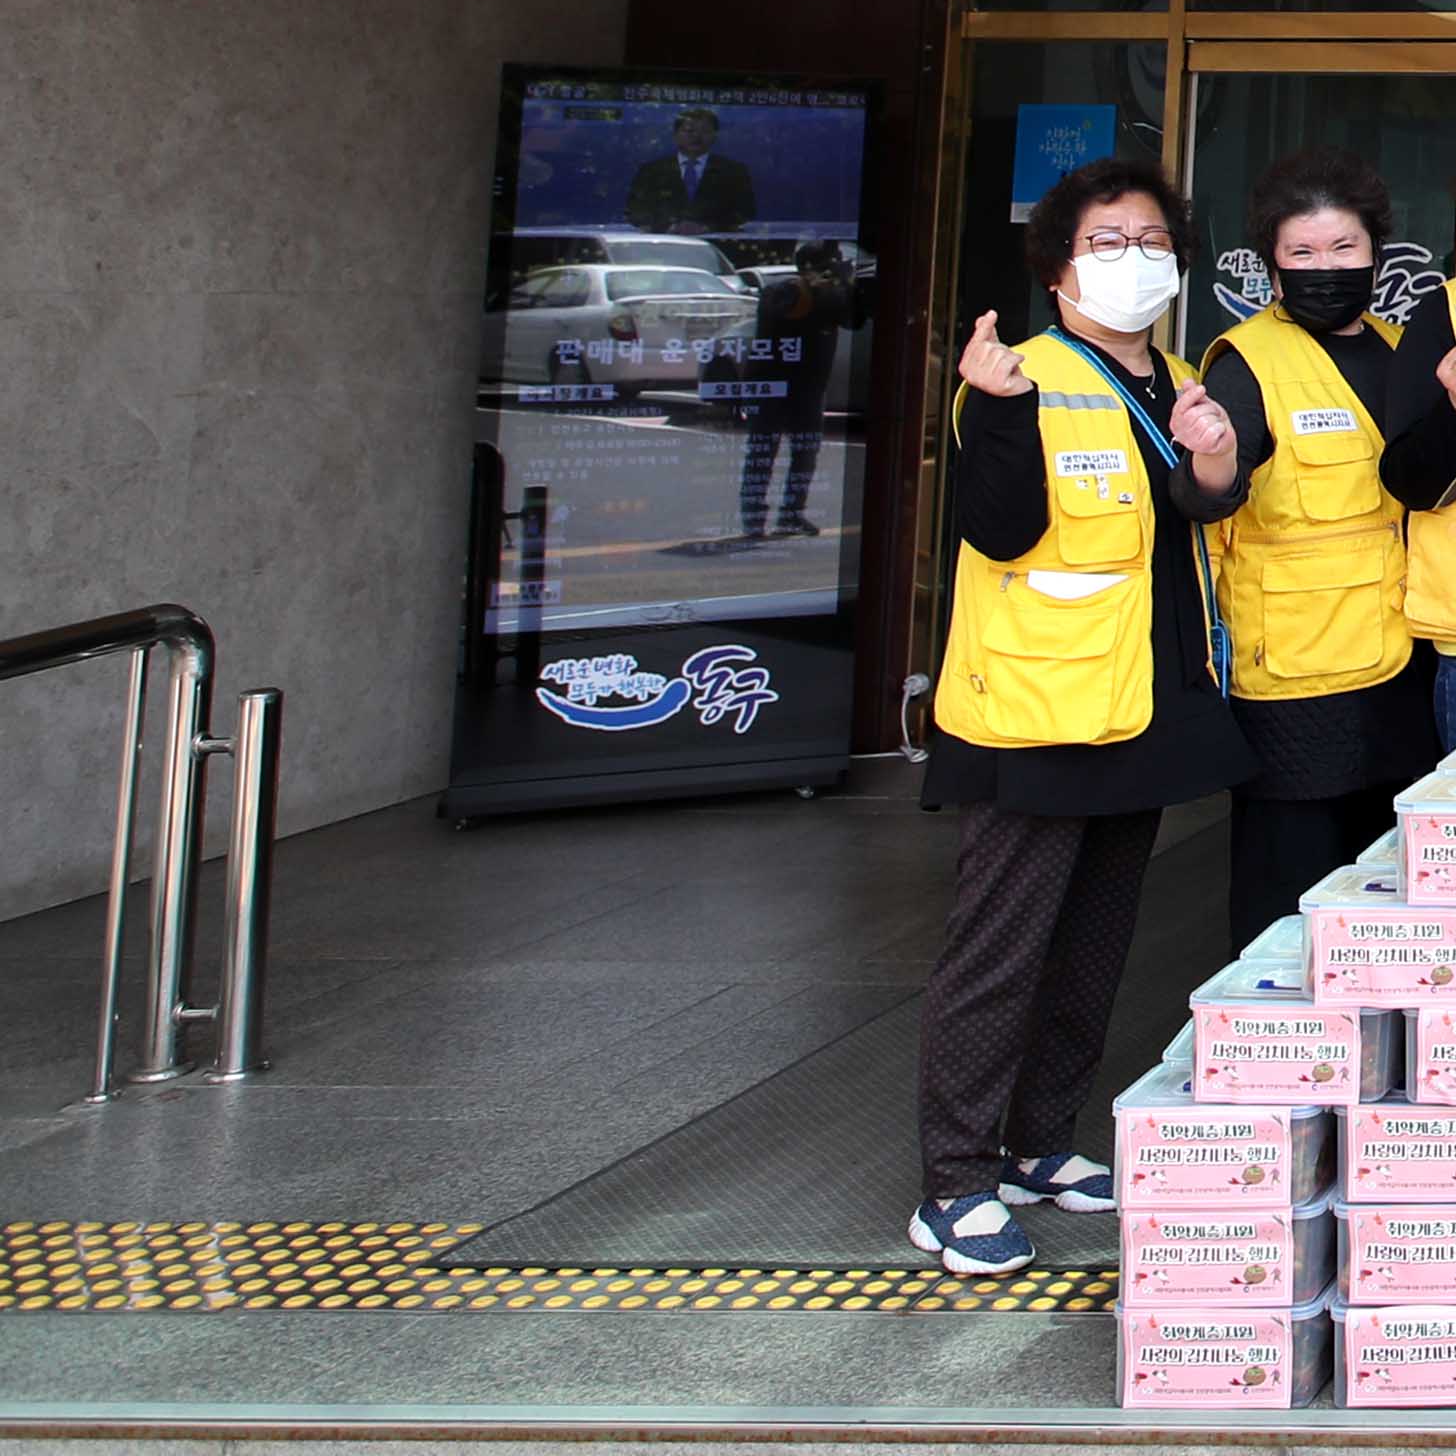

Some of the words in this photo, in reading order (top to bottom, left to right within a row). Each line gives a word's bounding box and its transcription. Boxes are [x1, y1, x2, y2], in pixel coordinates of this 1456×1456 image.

[1246, 278, 1272, 301] 모두
[556, 338, 645, 366] 판매대
[683, 645, 779, 734] 동구
[1223, 1123, 1252, 1138] 지원
[1139, 1146, 1182, 1163] 사랑의
[1185, 1146, 1243, 1163] 김치나눔
[1246, 1145, 1278, 1161] 행사
[1365, 1243, 1408, 1260] 사랑의
[1224, 1324, 1253, 1339] 지원
[1140, 1345, 1183, 1363] 사랑의
[1186, 1346, 1245, 1364] 김치나눔
[1247, 1347, 1279, 1363] 행사
